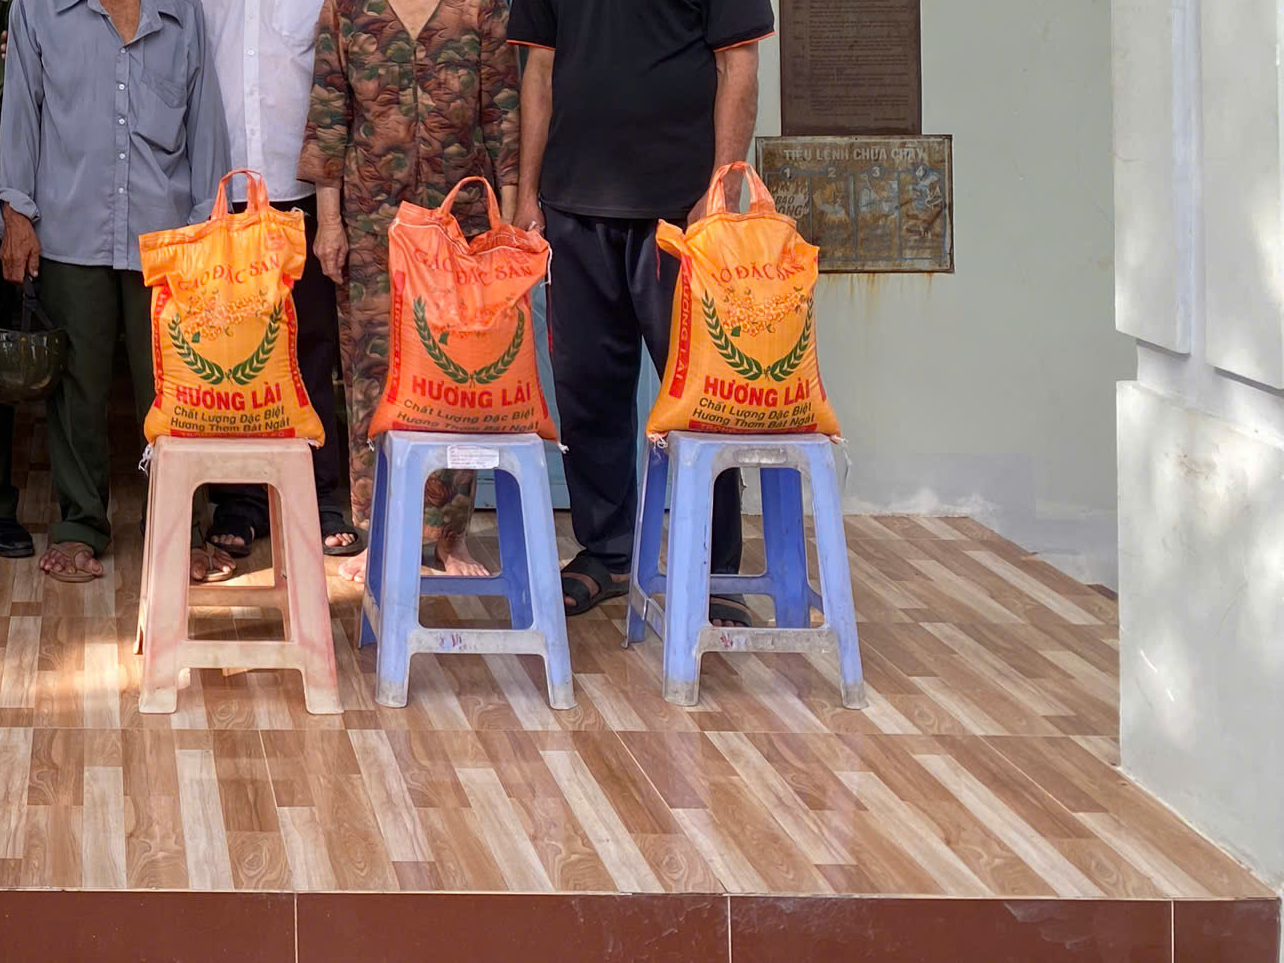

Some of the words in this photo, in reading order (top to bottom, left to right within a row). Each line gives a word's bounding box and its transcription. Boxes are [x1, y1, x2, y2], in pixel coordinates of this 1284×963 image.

[783, 167, 791, 178] 1
[827, 167, 837, 178] 2
[872, 167, 881, 177] 3
[916, 166, 925, 176] 4
[176, 385, 245, 411] HƯƠNG
[251, 381, 282, 409] LÀI
[412, 375, 493, 409] HƯƠNG
[704, 375, 778, 407] HƯƠNG
[174, 405, 198, 420] Chất
[699, 397, 727, 413] Chất
